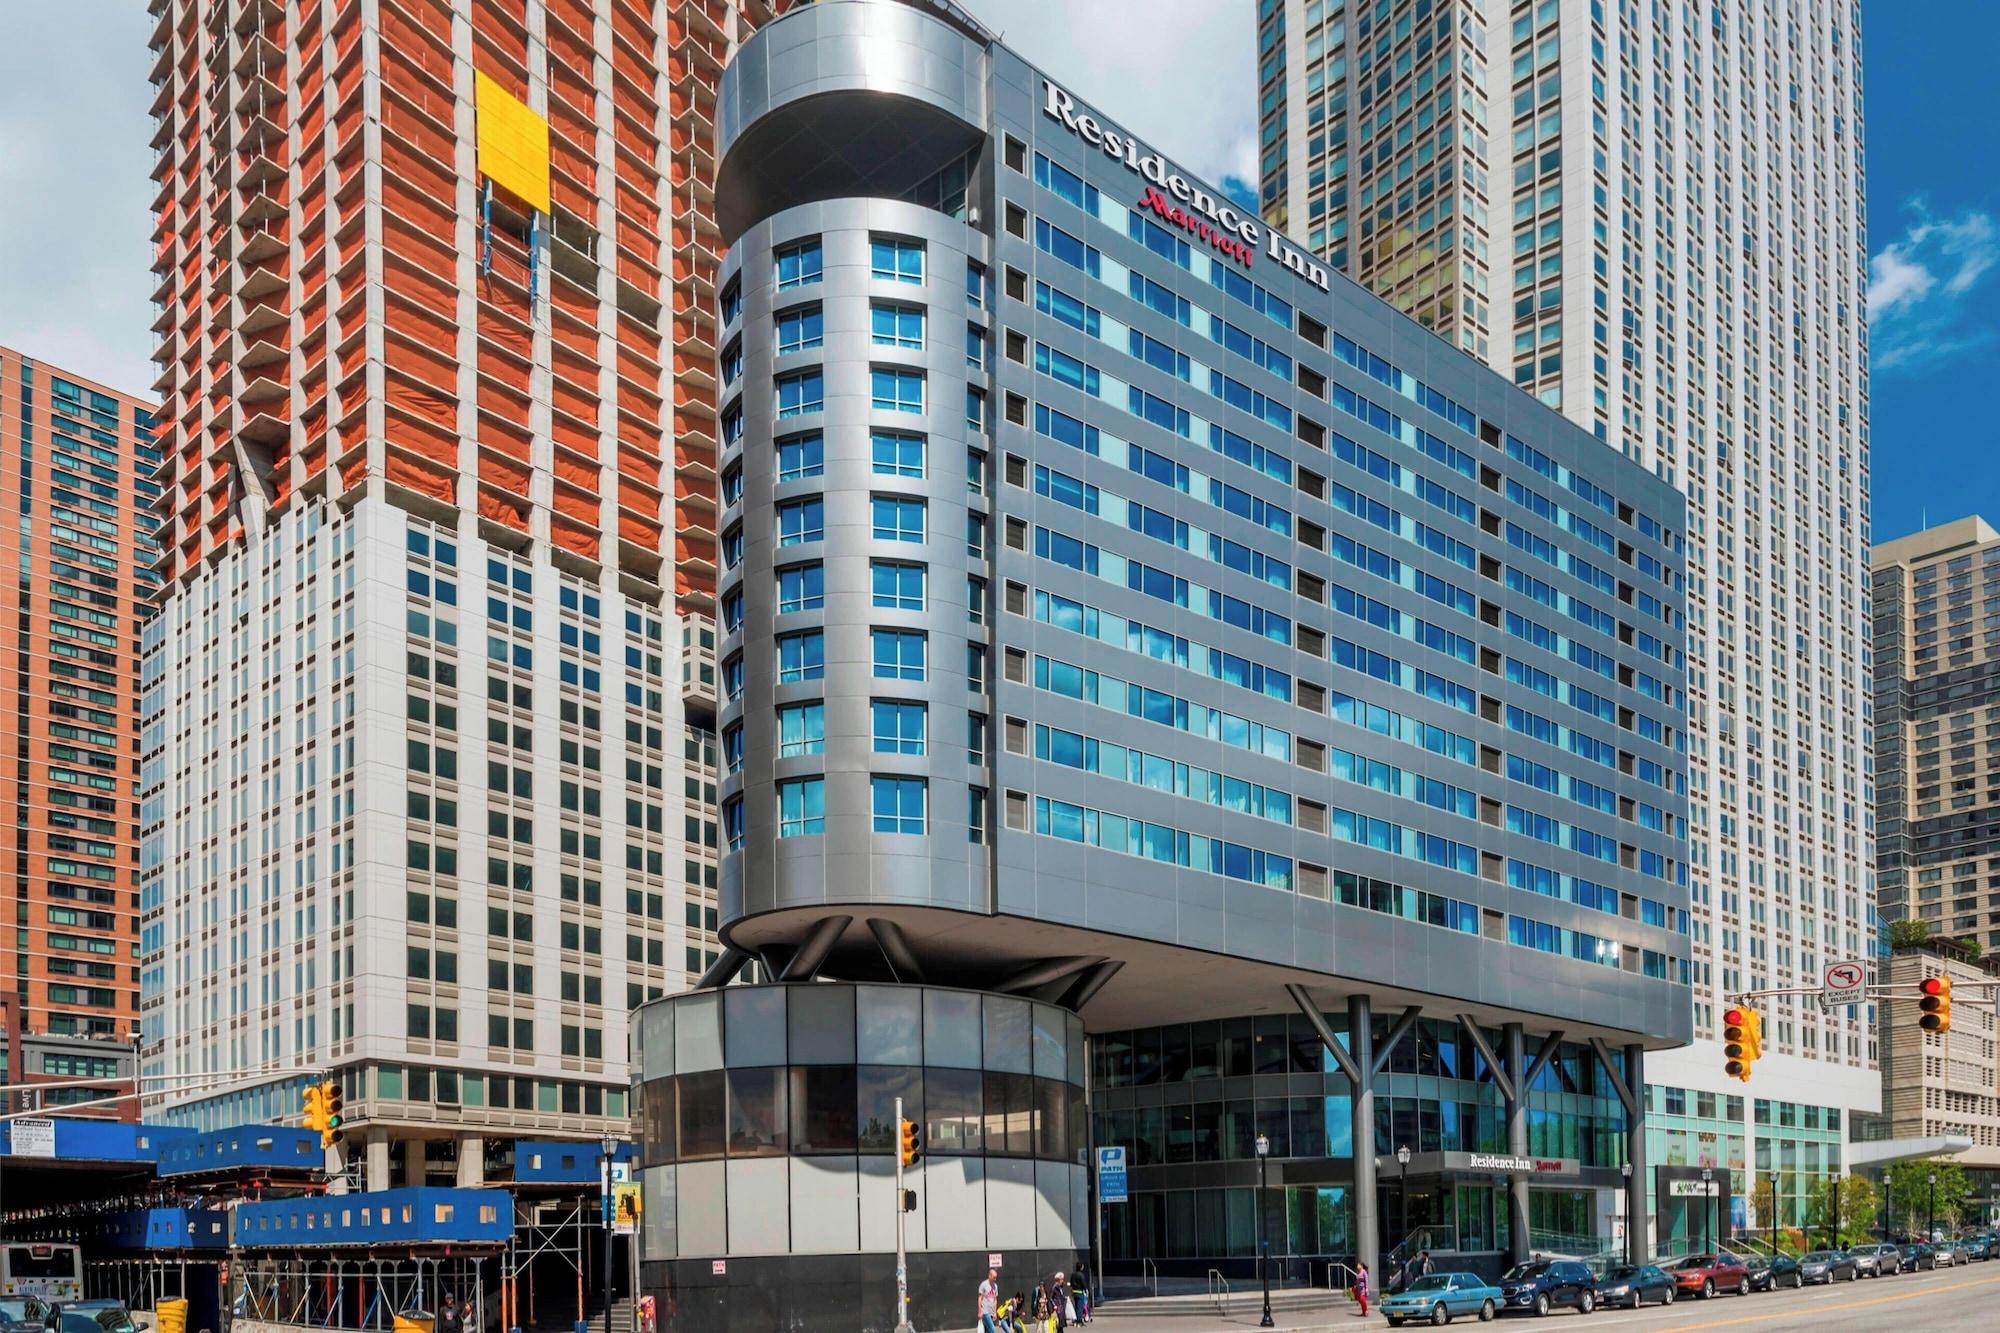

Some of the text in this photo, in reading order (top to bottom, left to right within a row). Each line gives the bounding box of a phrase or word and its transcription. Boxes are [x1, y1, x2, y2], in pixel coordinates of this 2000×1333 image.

[1043, 79, 1331, 293] Residence Inn
[1138, 186, 1253, 268] Marriott
[1828, 989, 1860, 997] EXCEPT
[1830, 995, 1859, 1003] BUSES
[1470, 1153, 1531, 1170] Residence Inn
